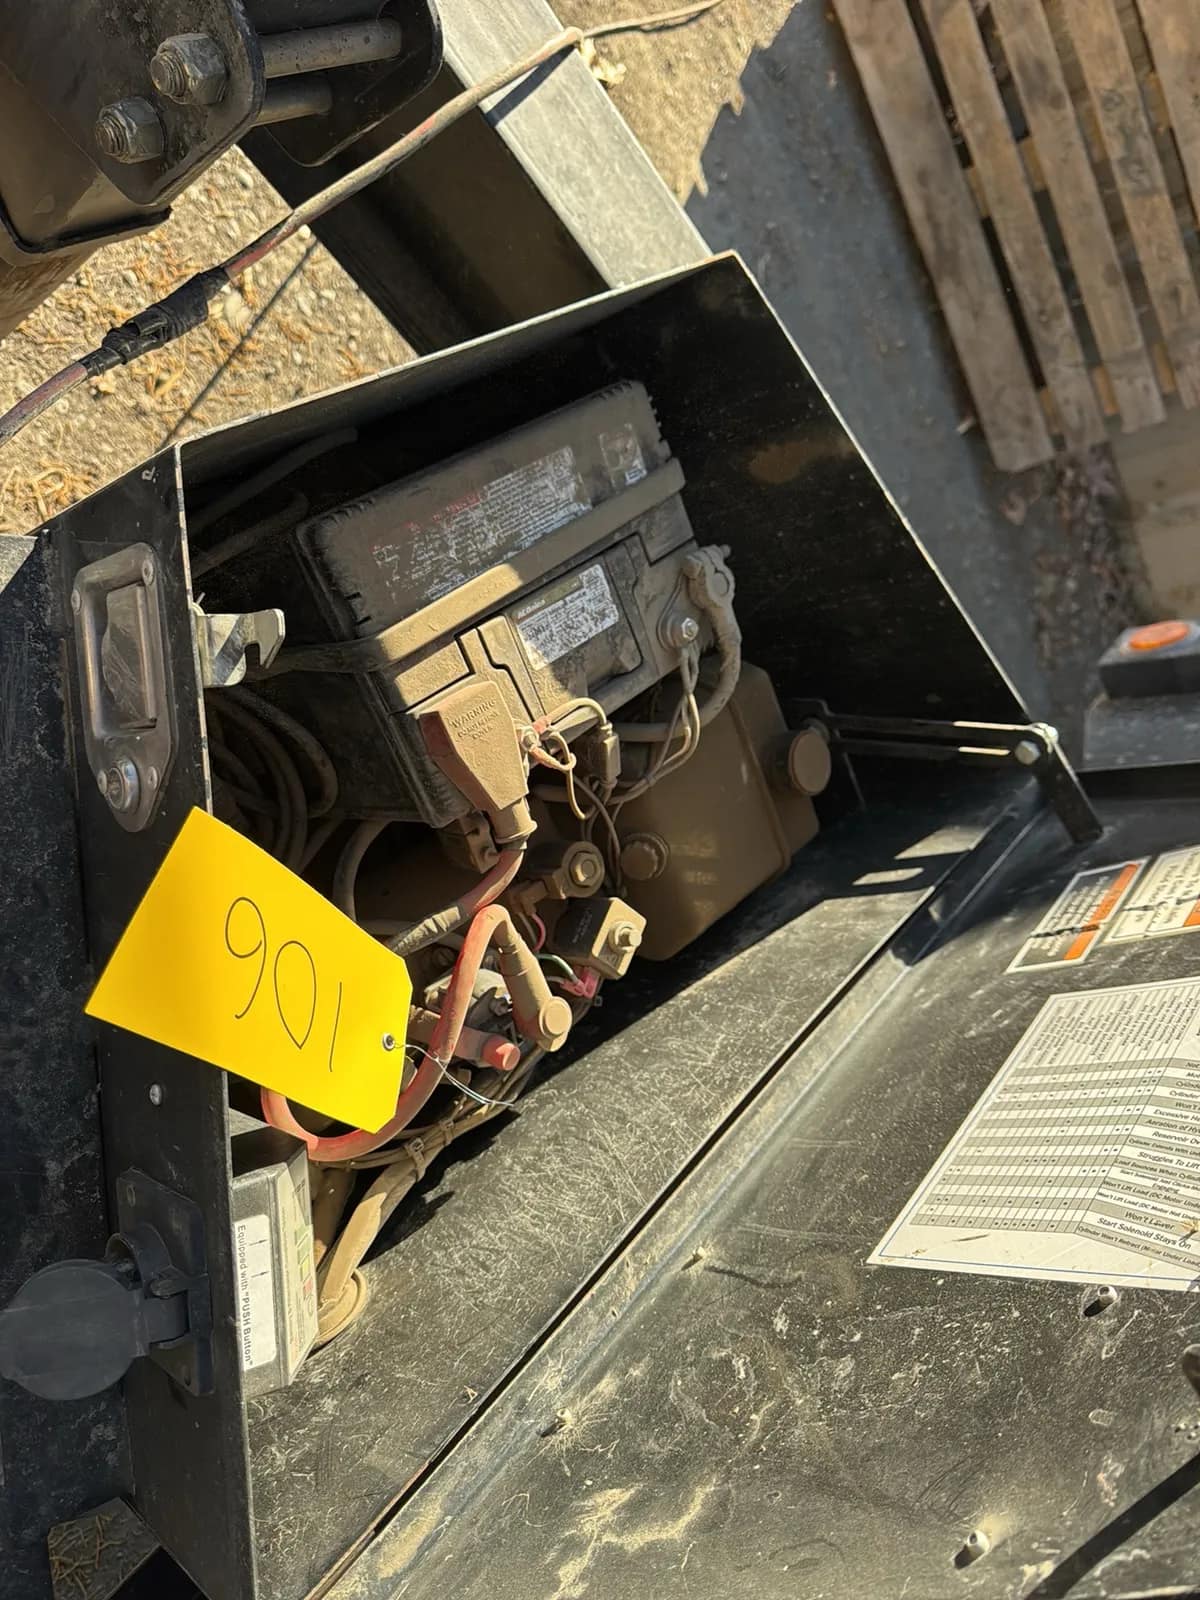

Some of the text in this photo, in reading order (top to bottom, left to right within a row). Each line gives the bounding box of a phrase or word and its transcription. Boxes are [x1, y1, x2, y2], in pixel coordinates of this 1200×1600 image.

[451, 700, 496, 729] WARNING
[1137, 1151, 1173, 1163] Struggles
[1124, 1210, 1149, 1223] Won't
[1097, 1217, 1193, 1250] Start Solenoid Stays On
[237, 1224, 249, 1272] Equipped
[240, 1269, 249, 1293] with
